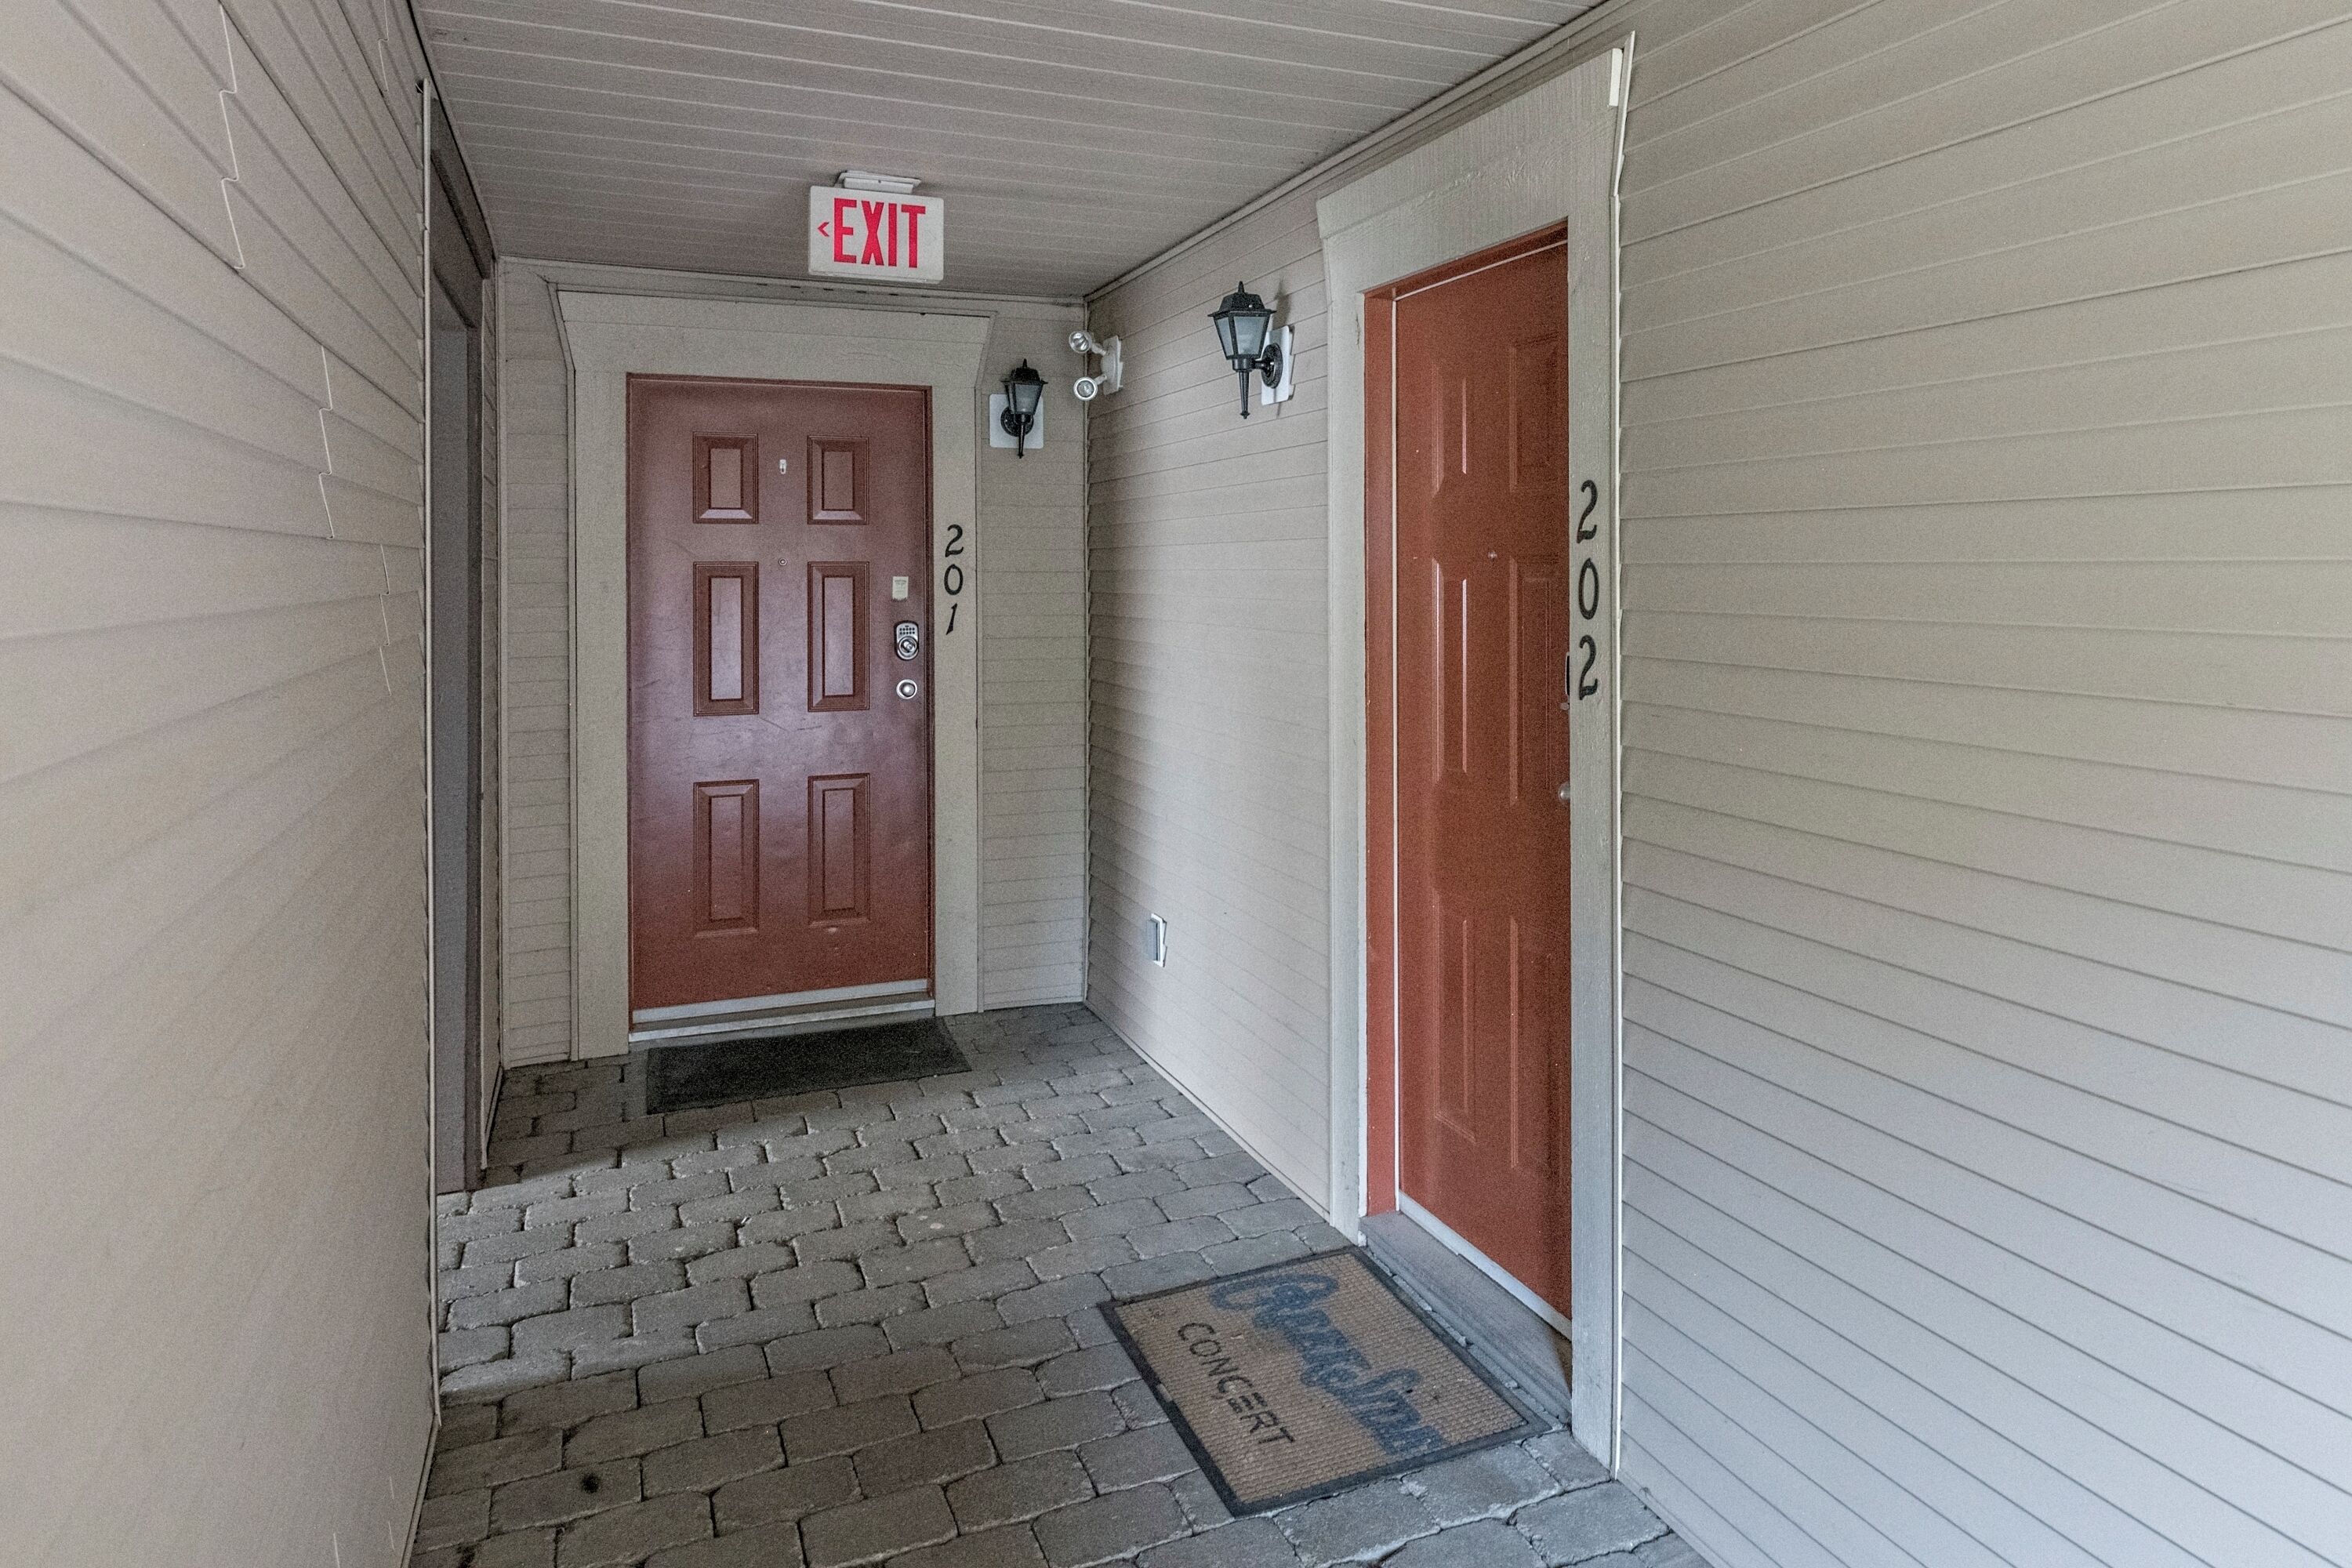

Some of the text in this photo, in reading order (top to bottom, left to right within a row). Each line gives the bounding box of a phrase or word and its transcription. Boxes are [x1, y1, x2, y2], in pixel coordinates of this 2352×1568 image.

[833, 198, 926, 268] EXIT
[943, 524, 964, 635] 201
[1576, 479, 1599, 700] 202
[1178, 1323, 1295, 1443] CONCERT
